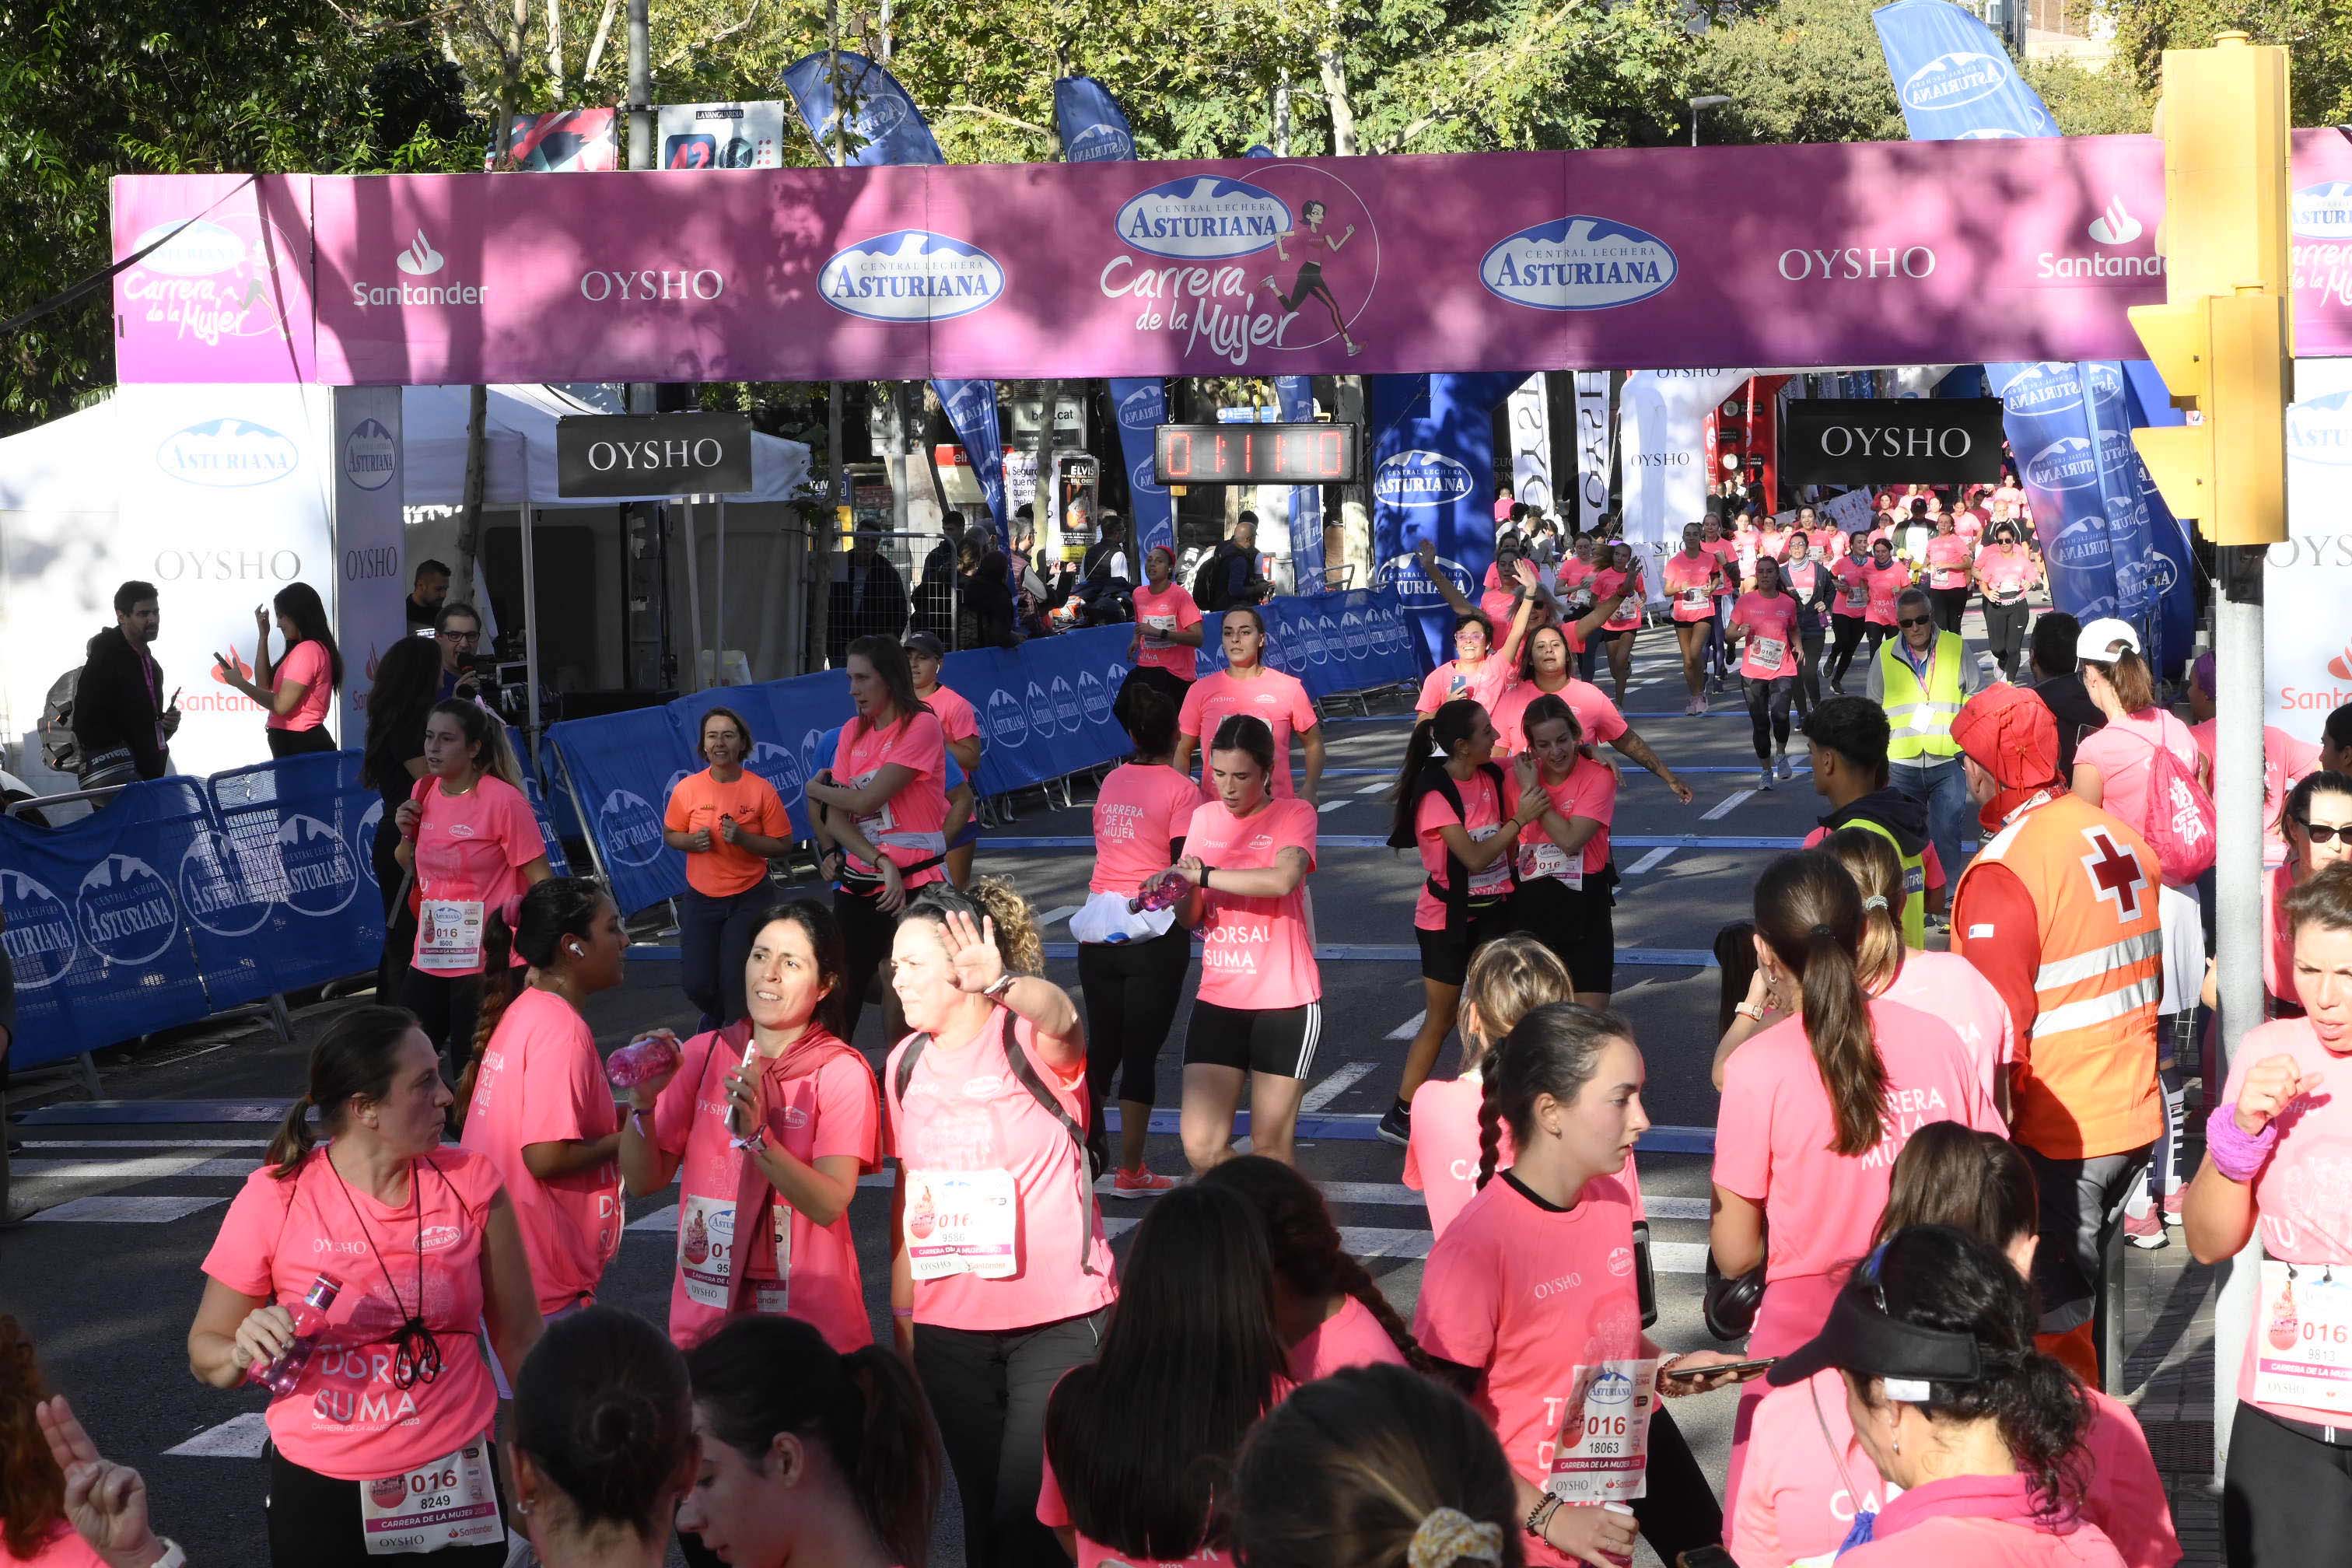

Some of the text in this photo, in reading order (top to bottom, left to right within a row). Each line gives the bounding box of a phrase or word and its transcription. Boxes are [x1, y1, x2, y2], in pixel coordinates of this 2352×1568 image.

[1156, 203, 1273, 213] CENTRAL LECHERA
[1129, 207, 1278, 238] ASTURIANA
[1525, 247, 1656, 258] CENTRAL LECHERA
[1494, 252, 1663, 287] ASTURIANA
[1778, 247, 1936, 281] OYSHO
[124, 271, 218, 300] Carrera
[580, 269, 724, 302] OYSHO
[832, 266, 990, 299] ASTURIANA
[1101, 256, 1245, 299] Carrera
[353, 281, 488, 306] Santander
[145, 301, 164, 322] de
[177, 296, 250, 346] Mujer
[1136, 293, 1300, 366] de la Mujer
[1031, 408, 1074, 422] b.cat
[1821, 427, 1972, 459] OYSHO
[170, 444, 289, 470] ASTURIANA
[348, 449, 394, 474] ASTURIANA
[588, 438, 723, 471] OYSHO
[1631, 453, 1689, 467] OYSHO
[1070, 465, 1094, 475] ELVIS
[1013, 479, 1025, 488] que
[1377, 473, 1465, 494] ASTURIANA
[155, 549, 302, 581] OYSHO
[346, 546, 397, 582] OYSHO
[1101, 803, 1144, 819] CARRERA
[1105, 815, 1133, 828] DE LA
[1103, 826, 1135, 839] MUJER
[436, 928, 458, 938] 016
[1205, 949, 1255, 968] SUMA
[313, 1238, 366, 1255] OYSHO
[692, 1272, 716, 1283] CARRERA
[717, 1263, 730, 1273] 95
[691, 1285, 717, 1299] OYSHO
[1534, 1272, 1582, 1301] OYSHO
[2303, 1321, 2348, 1343] 016
[2270, 1363, 2305, 1374] CARRERA
[1589, 1388, 1631, 1397] ASTURIANA
[2267, 1381, 2306, 1395] OYSHO
[313, 1388, 417, 1423] SUMA
[1587, 1416, 1626, 1436] 016
[1589, 1442, 1619, 1454] 18063
[411, 1469, 458, 1493] 016
[1556, 1479, 1588, 1491] OYSHO
[421, 1494, 451, 1510] 8249
[380, 1518, 421, 1528] CARRERA
[448, 1509, 473, 1519] MUJER
[379, 1524, 493, 1548] OYSHO Santander
